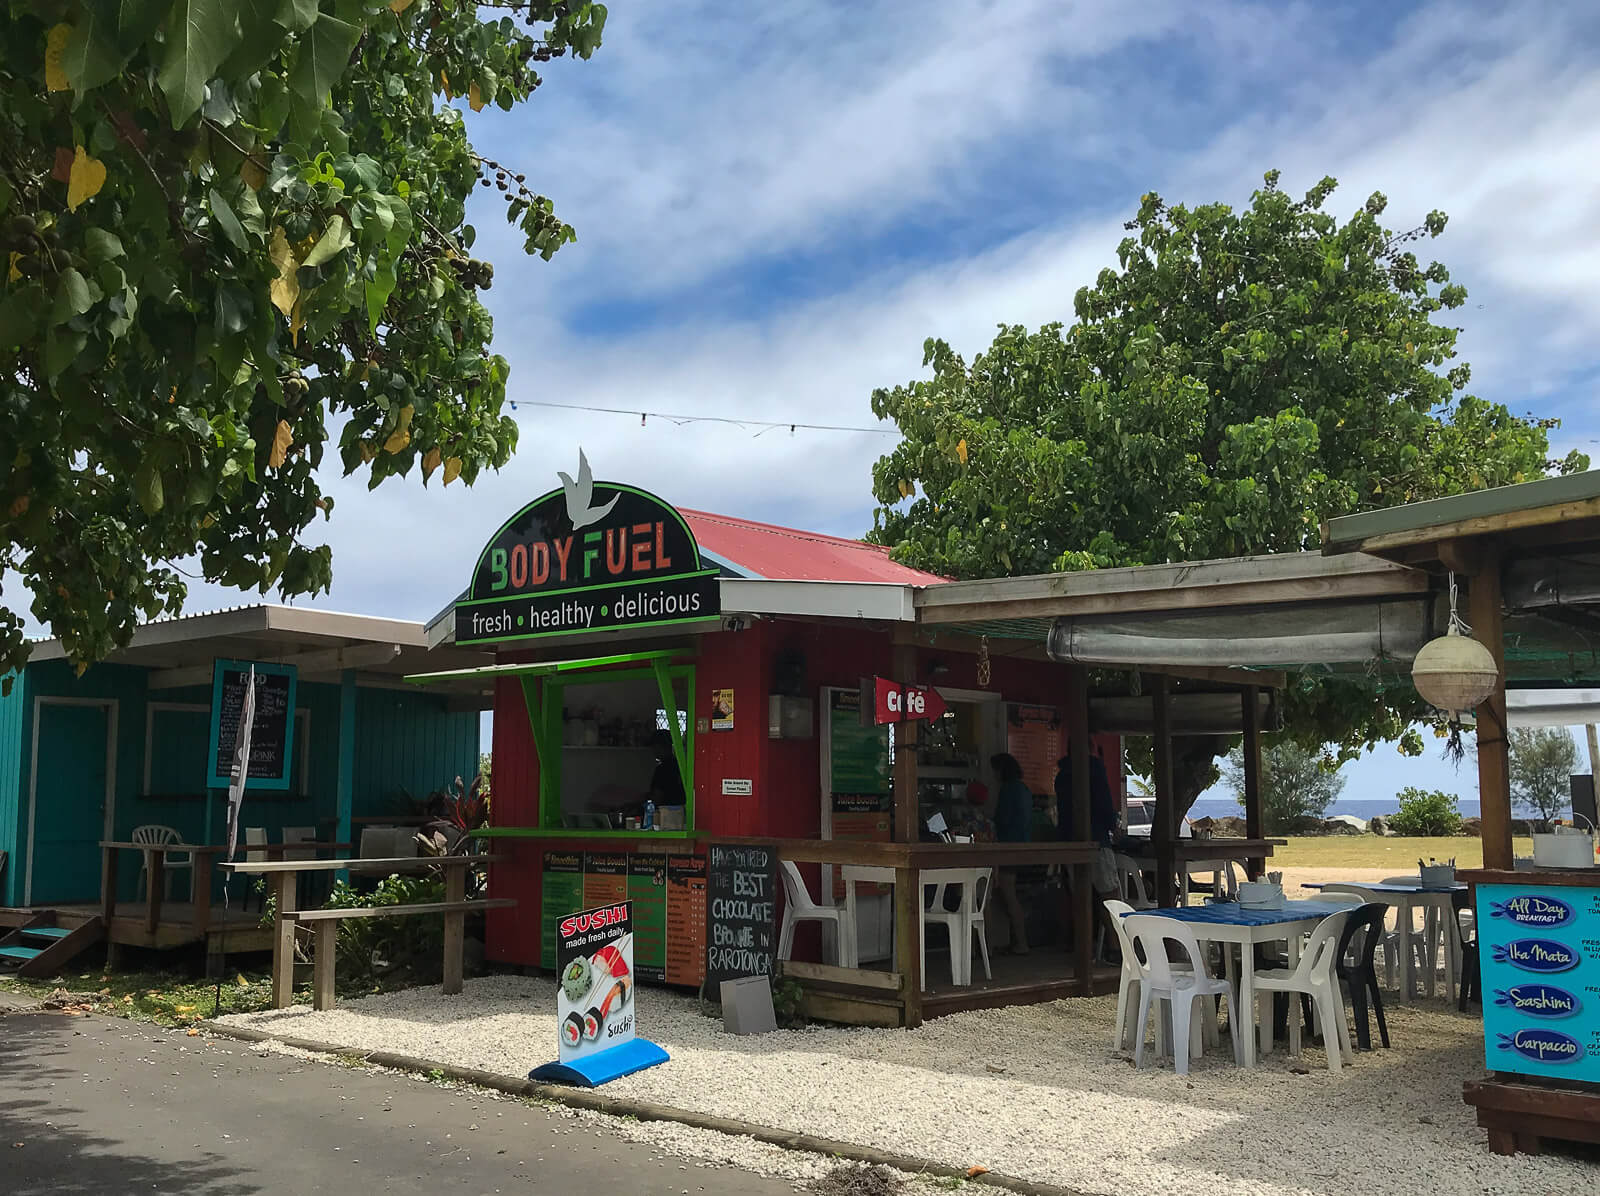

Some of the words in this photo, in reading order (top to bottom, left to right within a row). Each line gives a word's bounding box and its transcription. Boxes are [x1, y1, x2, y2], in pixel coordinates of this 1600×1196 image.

[490, 535, 574, 592] BODY
[583, 520, 672, 579] FUEL
[472, 609, 512, 635] fresh
[529, 599, 595, 629] healthy
[614, 590, 701, 620] delicious
[733, 870, 768, 897] BEST
[560, 904, 628, 938] SUSHI
[712, 898, 773, 923] CHOCOLATE
[1507, 898, 1530, 914] All
[1532, 898, 1568, 920] Day
[1516, 913, 1557, 923] BREAKFAST
[565, 936, 587, 949] made
[588, 930, 606, 943] fresh
[607, 926, 624, 937] daily
[760, 932, 770, 947] IN
[1509, 943, 1530, 960] Ika
[1531, 944, 1571, 963] Mata
[1510, 988, 1571, 1010] Sashimi
[1515, 1030, 1576, 1059] Carpaccio
